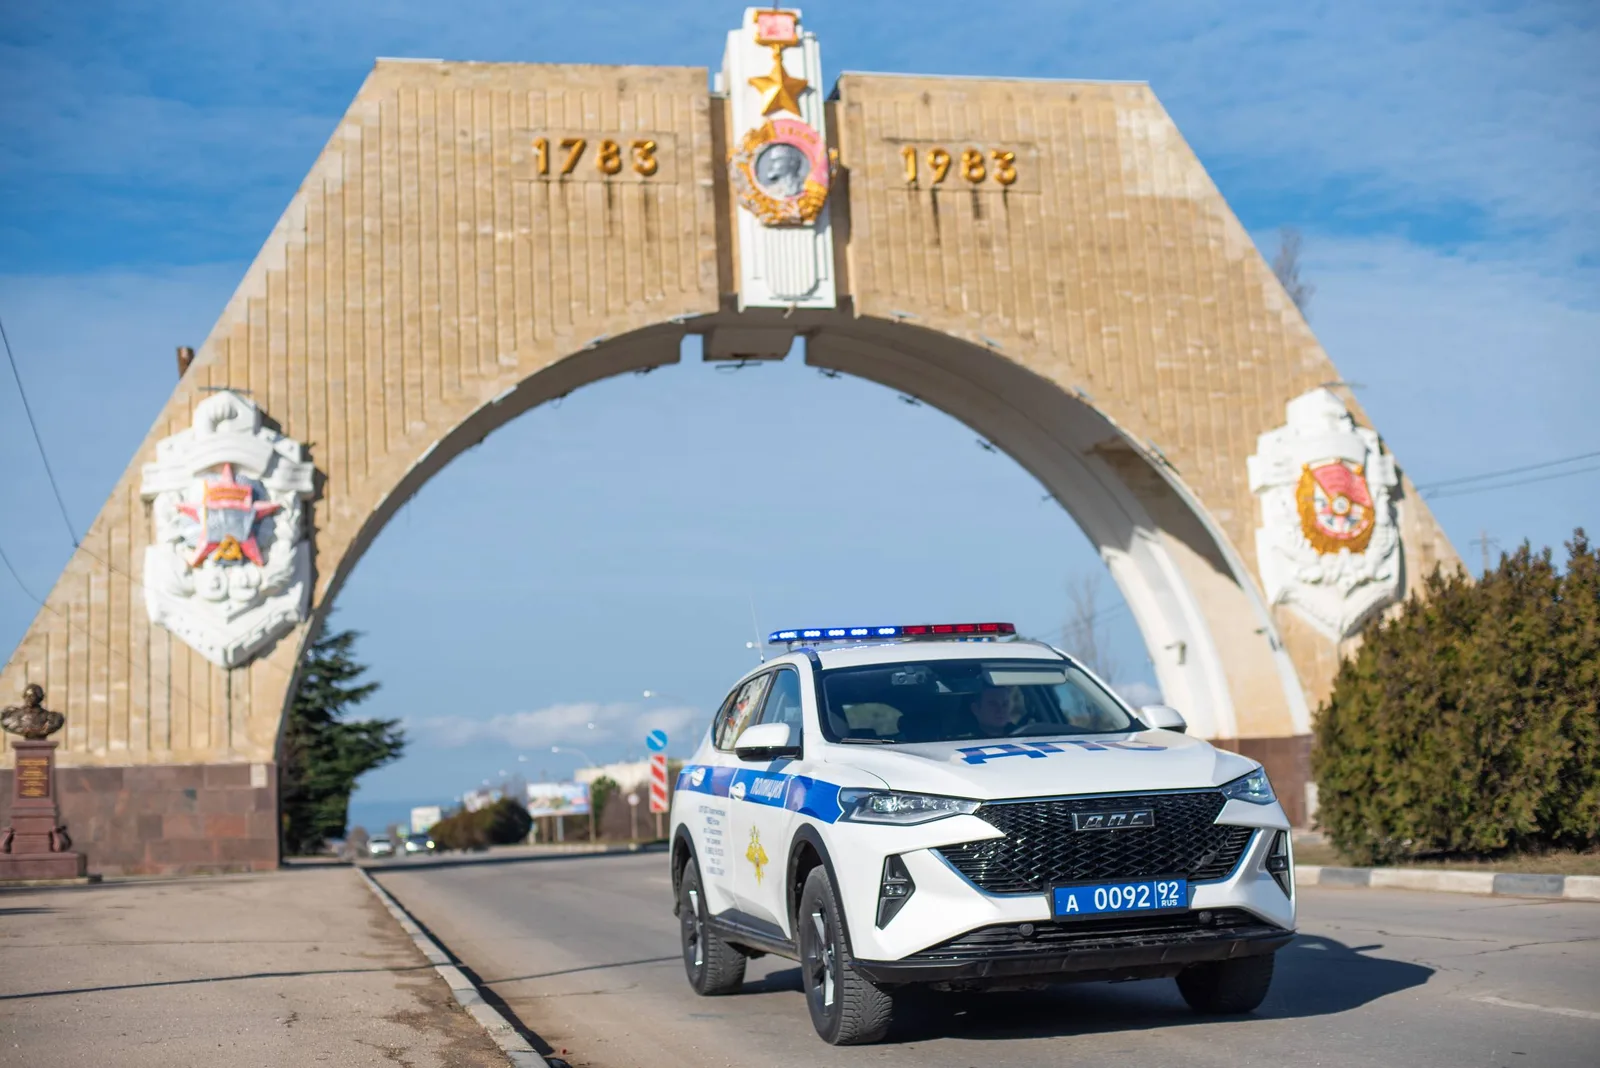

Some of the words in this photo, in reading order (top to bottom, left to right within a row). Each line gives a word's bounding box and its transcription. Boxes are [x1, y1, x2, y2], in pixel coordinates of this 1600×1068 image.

[533, 137, 658, 176] 1783
[901, 146, 1018, 185] 1983
[955, 739, 1168, 765] ДПС
[1082, 812, 1148, 829] ДПС
[1066, 894, 1079, 912] А
[1094, 885, 1151, 910] 0092
[1157, 881, 1180, 900] 92
[1161, 899, 1178, 907] RUS
